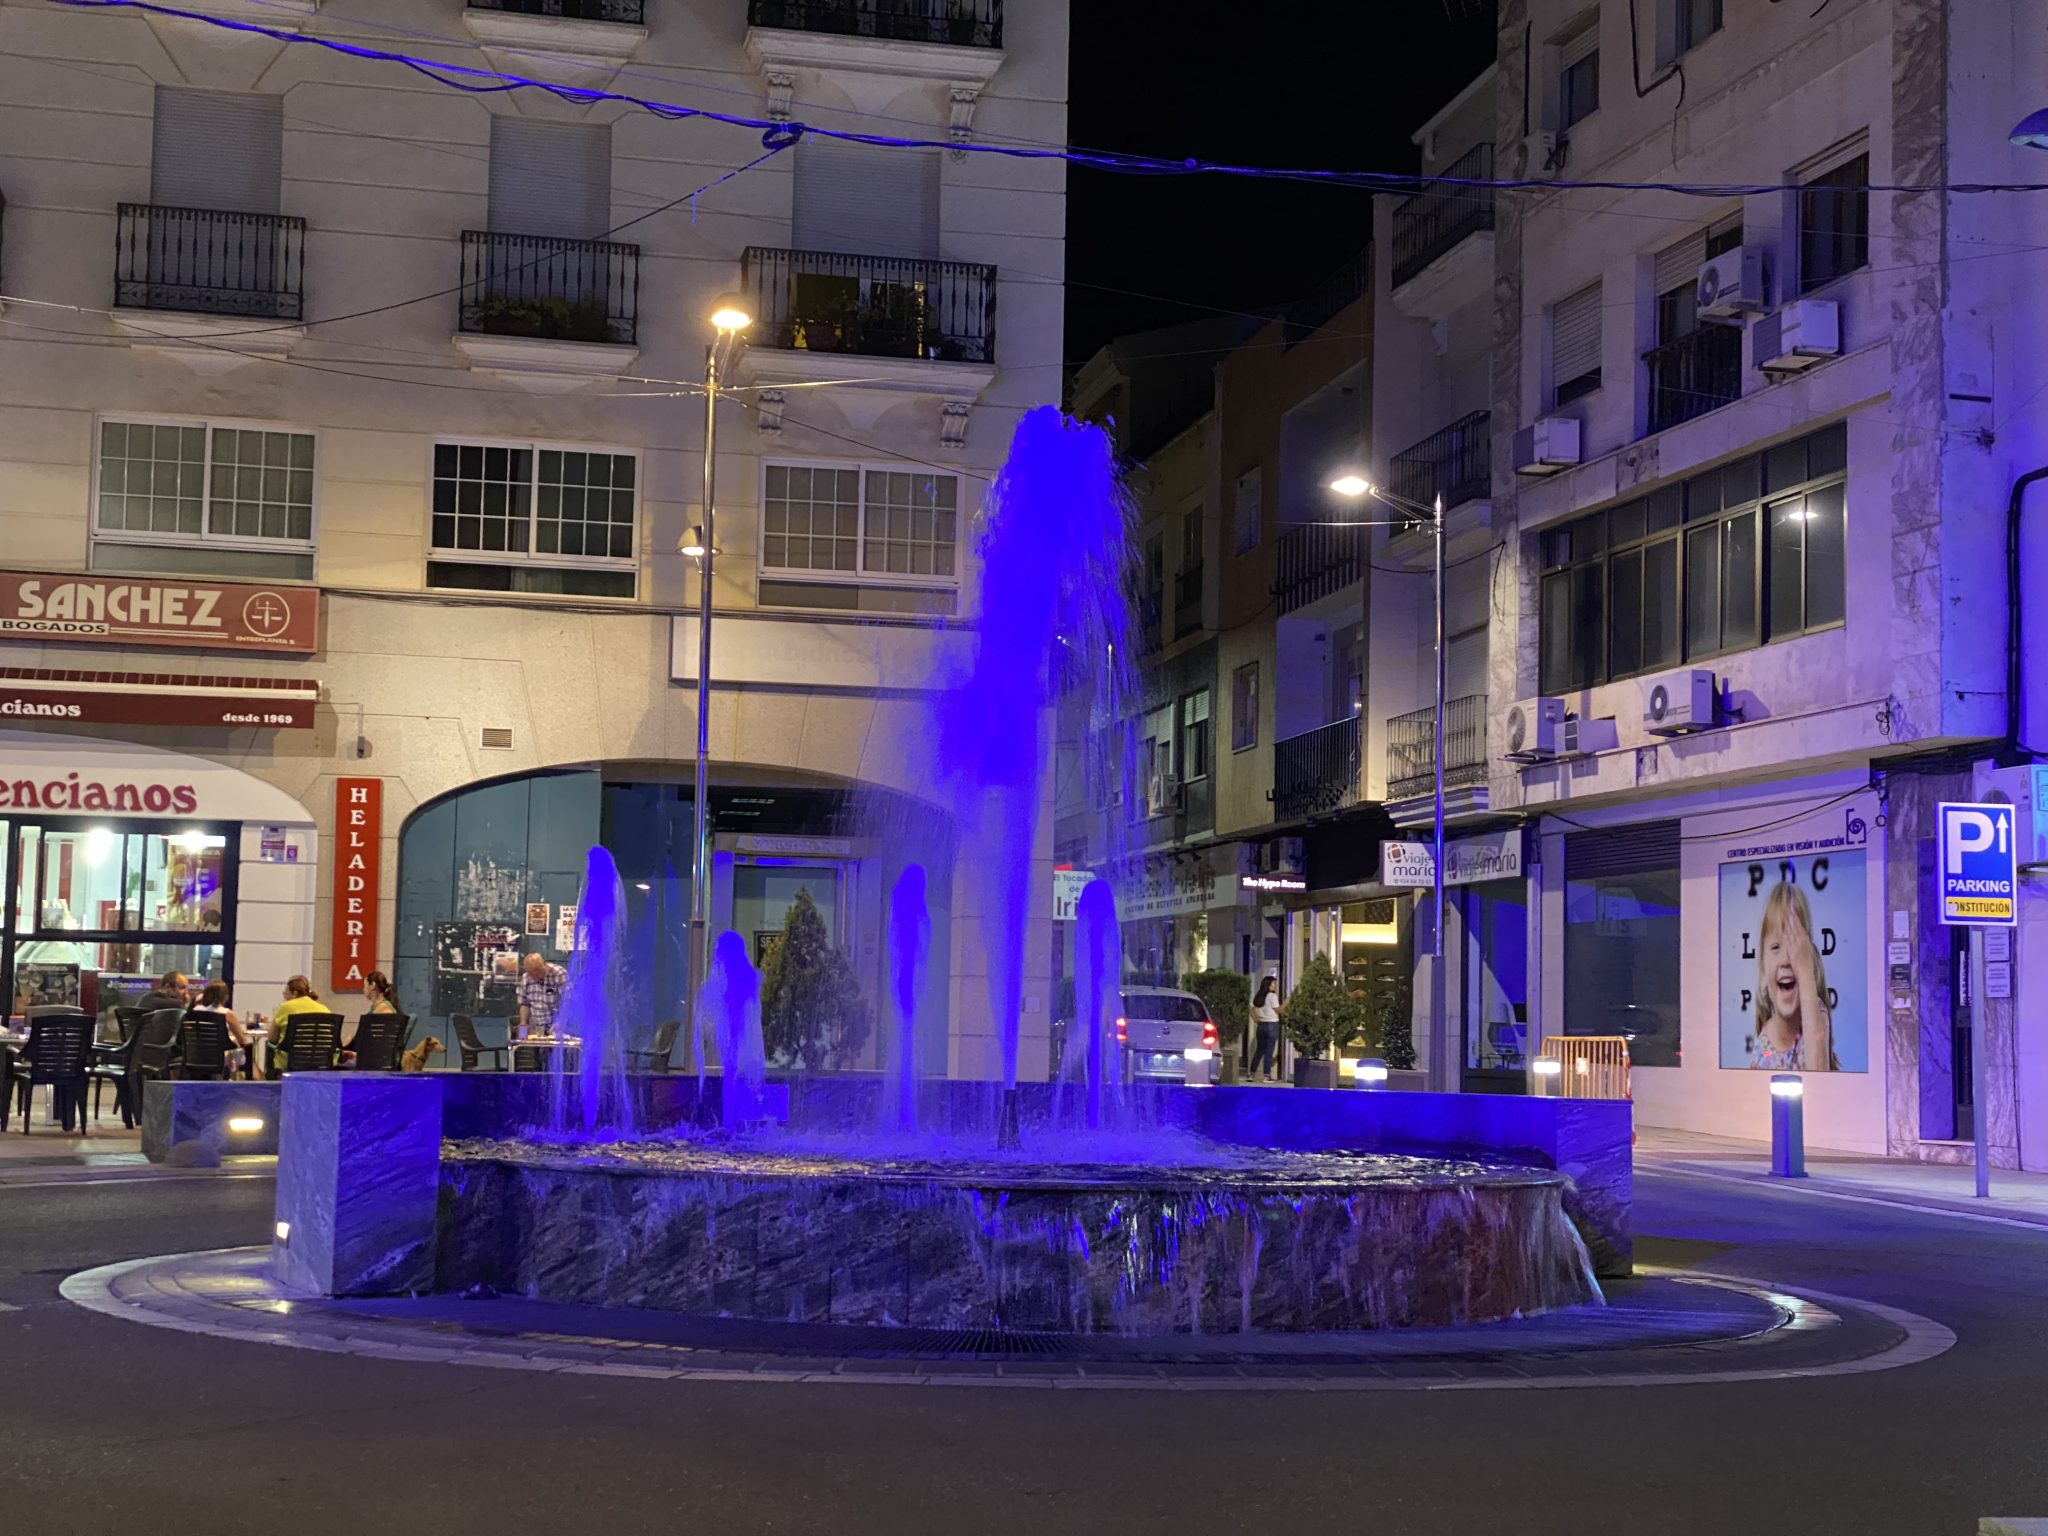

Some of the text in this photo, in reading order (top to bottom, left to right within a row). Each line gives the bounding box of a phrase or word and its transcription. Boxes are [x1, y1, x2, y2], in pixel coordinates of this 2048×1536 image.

[17, 580, 222, 627] SANCHEZ
[2, 620, 106, 634] BOGADOS
[0, 699, 81, 717] cianos
[222, 713, 293, 724] desde 1969
[1946, 810, 1995, 874] P
[1727, 848, 1747, 858] CENTRO
[345, 787, 368, 980] HELADERÍA
[1243, 876, 1257, 887] The
[1281, 880, 1305, 888] Room
[1748, 864, 1764, 897] P
[1811, 857, 1829, 891] C
[1947, 879, 2011, 893] PARKING
[1948, 899, 2011, 913] ONSTITUCIÓN
[1742, 928, 1837, 959] L D
[1741, 990, 1752, 1011] P
